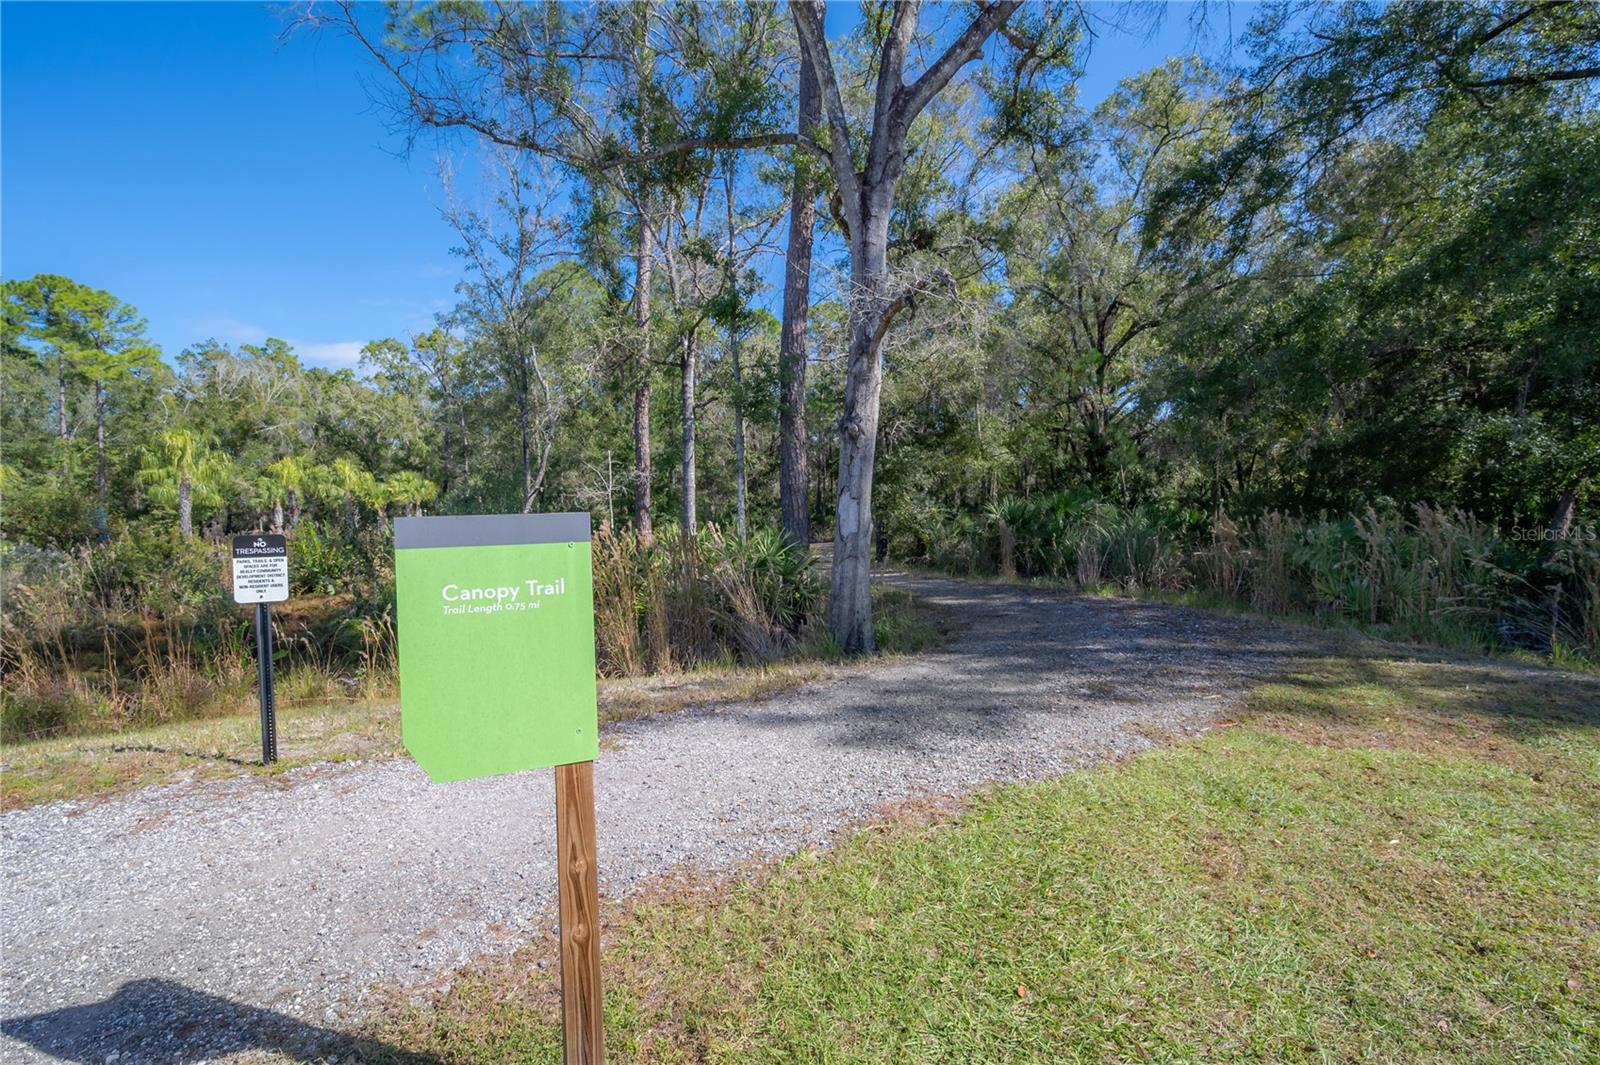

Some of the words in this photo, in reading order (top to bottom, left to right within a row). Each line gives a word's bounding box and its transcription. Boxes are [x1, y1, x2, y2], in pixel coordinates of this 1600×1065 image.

[442, 584, 520, 602] Canopy
[525, 578, 564, 596] Trail
[442, 605, 466, 615] Trail
[468, 603, 502, 614] Length
[505, 602, 526, 610] 0.75
[528, 600, 540, 608] mi
